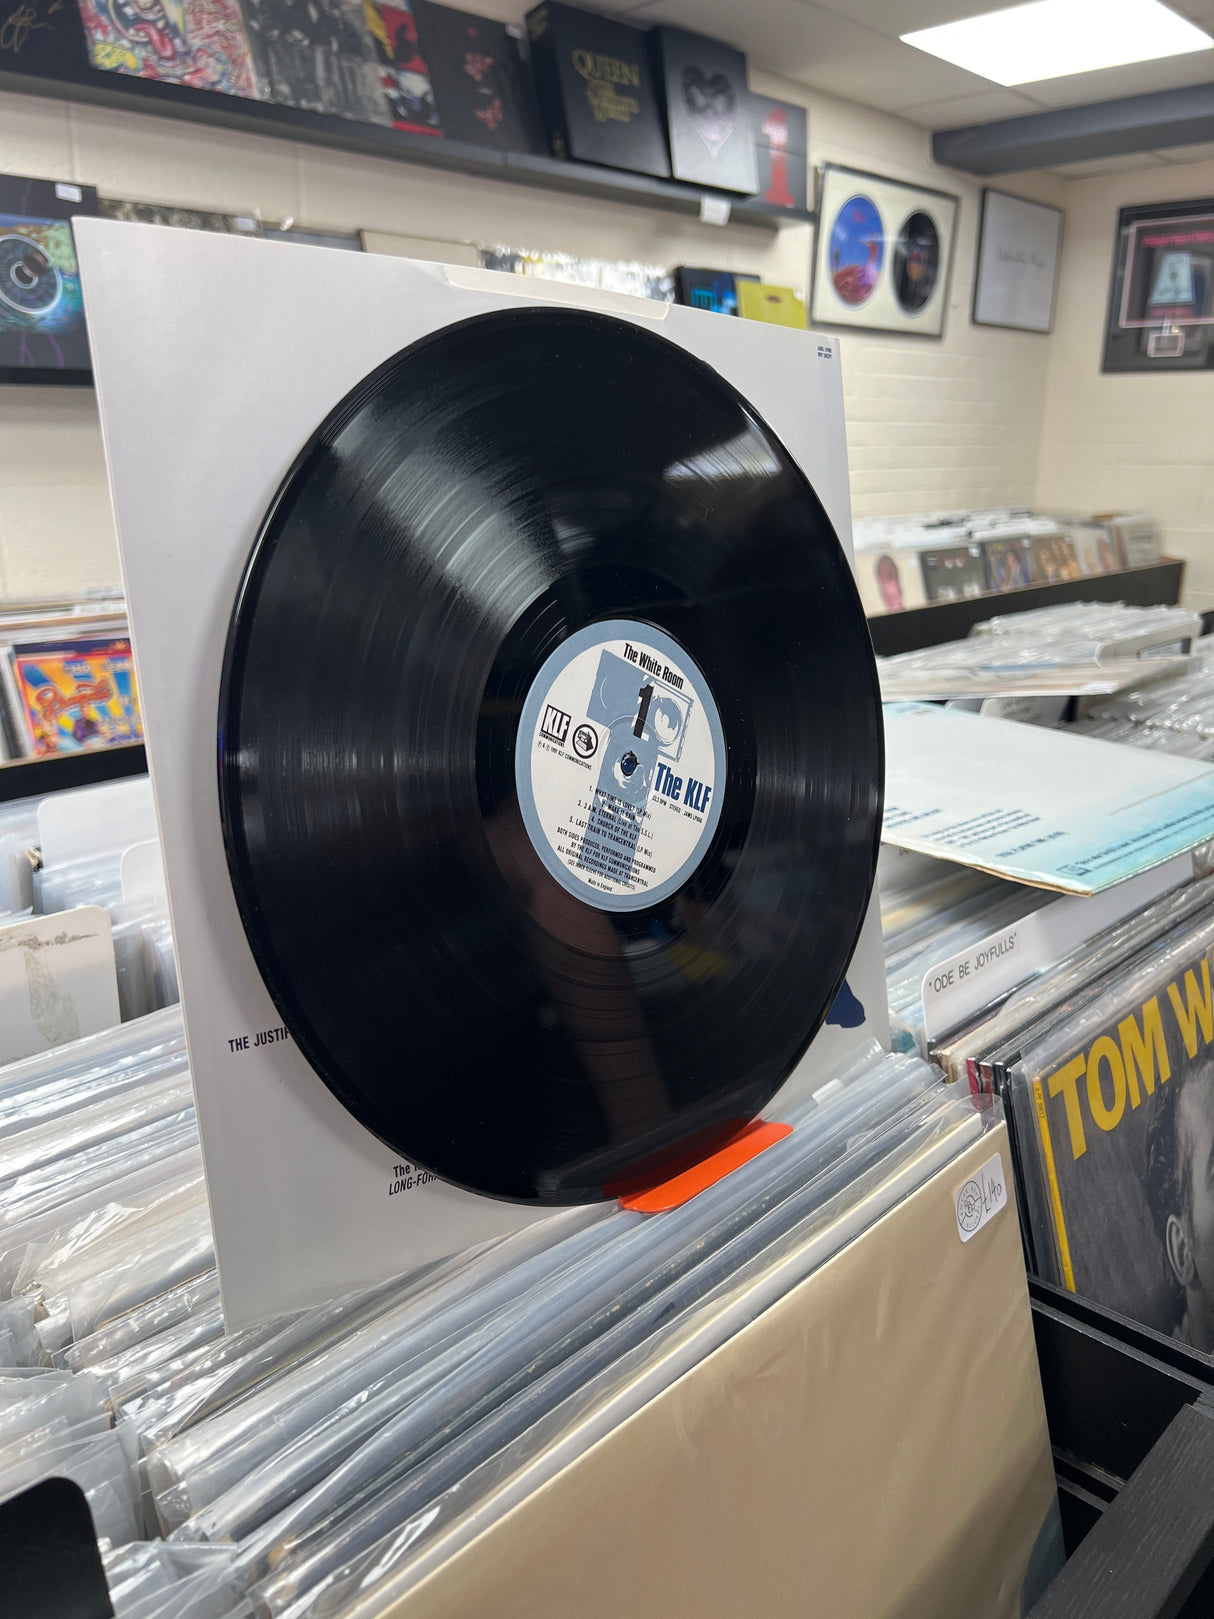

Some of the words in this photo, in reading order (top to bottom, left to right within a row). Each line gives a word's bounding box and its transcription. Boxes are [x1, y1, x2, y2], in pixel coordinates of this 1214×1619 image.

[624, 642, 638, 663] The
[639, 651, 662, 677] White
[662, 665, 684, 690] Room
[543, 705, 570, 741] KLF
[632, 684, 654, 739] 1
[539, 731, 565, 748] COMMUNICATIONS
[565, 753, 592, 770] COMMUNICATIONS
[595, 788, 607, 798] WHAT
[607, 793, 617, 803] TIME
[654, 762, 683, 801] The
[683, 777, 712, 813] KLF
[598, 809, 617, 822] ETERNAL
[633, 823, 641, 834] The
[608, 803, 620, 814] MAKE
[620, 809, 625, 817] IT
[625, 812, 636, 821] RAIN
[576, 818, 588, 829] LAST
[587, 823, 601, 835] TRAIN
[601, 829, 608, 838] TO
[608, 832, 636, 851] TRANCENTRAL
[597, 818, 613, 831] CHURCH
[614, 825, 620, 834] OF
[621, 827, 629, 838] THE
[629, 832, 638, 841] KLF
[557, 826, 568, 836] BOTH
[568, 831, 580, 841] SIDES
[601, 845, 624, 860] PERFORMED
[623, 855, 632, 863] AND
[632, 858, 657, 874] PROGRAMMED
[571, 841, 577, 849] BY
[577, 843, 585, 853] THE
[585, 847, 593, 856] KLF
[593, 850, 601, 859] FOR
[601, 854, 609, 862] KLF
[608, 857, 641, 876] COMMUNICATIONS
[557, 844, 565, 854] ALL
[565, 848, 583, 861] ORIGINAL
[584, 855, 608, 871] RECORDINGS
[607, 864, 618, 875] MADE
[618, 869, 625, 877] AT
[624, 871, 649, 888] TRANCENTRAL
[588, 878, 597, 886] Made
[600, 883, 613, 892] England
[958, 960, 970, 980] BE
[228, 1036, 250, 1053] THE
[1047, 996, 1171, 1161] TOM
[1166, 945, 1214, 1060] W
[393, 1164, 411, 1178] The
